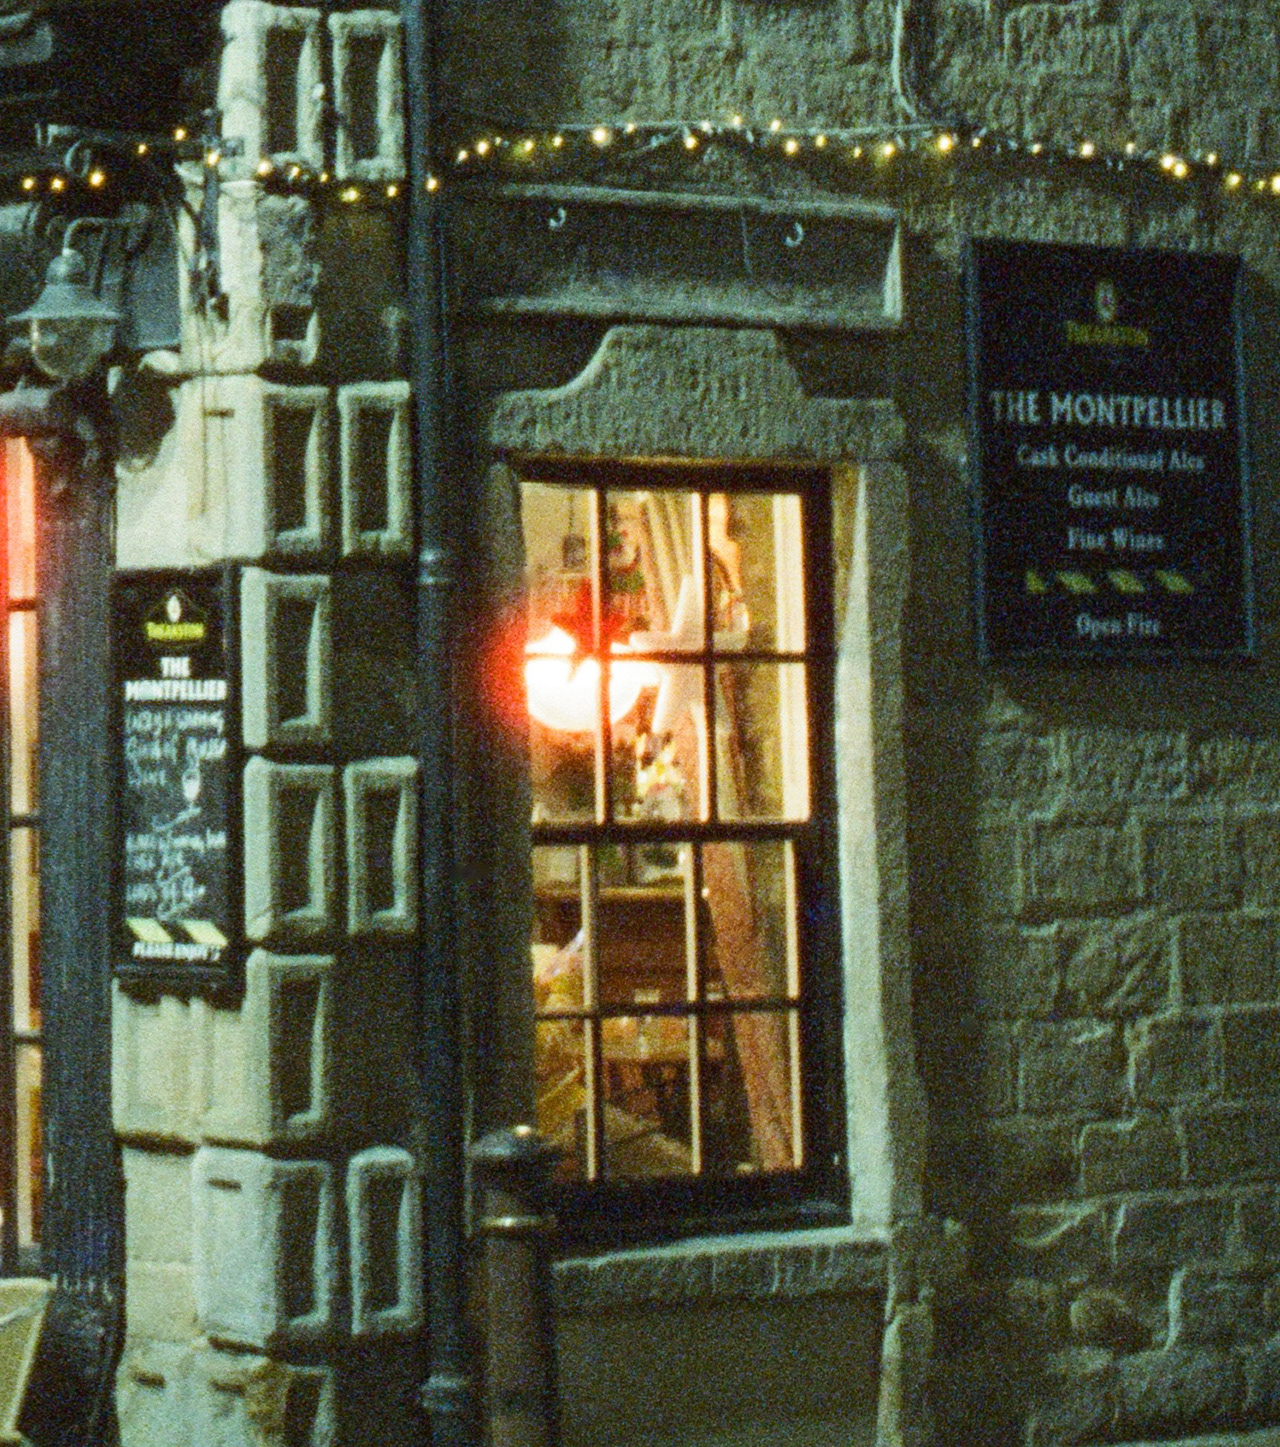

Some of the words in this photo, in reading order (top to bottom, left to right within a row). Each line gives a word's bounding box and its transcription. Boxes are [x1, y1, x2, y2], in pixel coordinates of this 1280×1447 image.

[989, 389, 1041, 425] THE
[1050, 391, 1226, 430] MONTPELLIER
[160, 656, 191, 678] THE
[125, 679, 228, 702] MONTPELLIER
